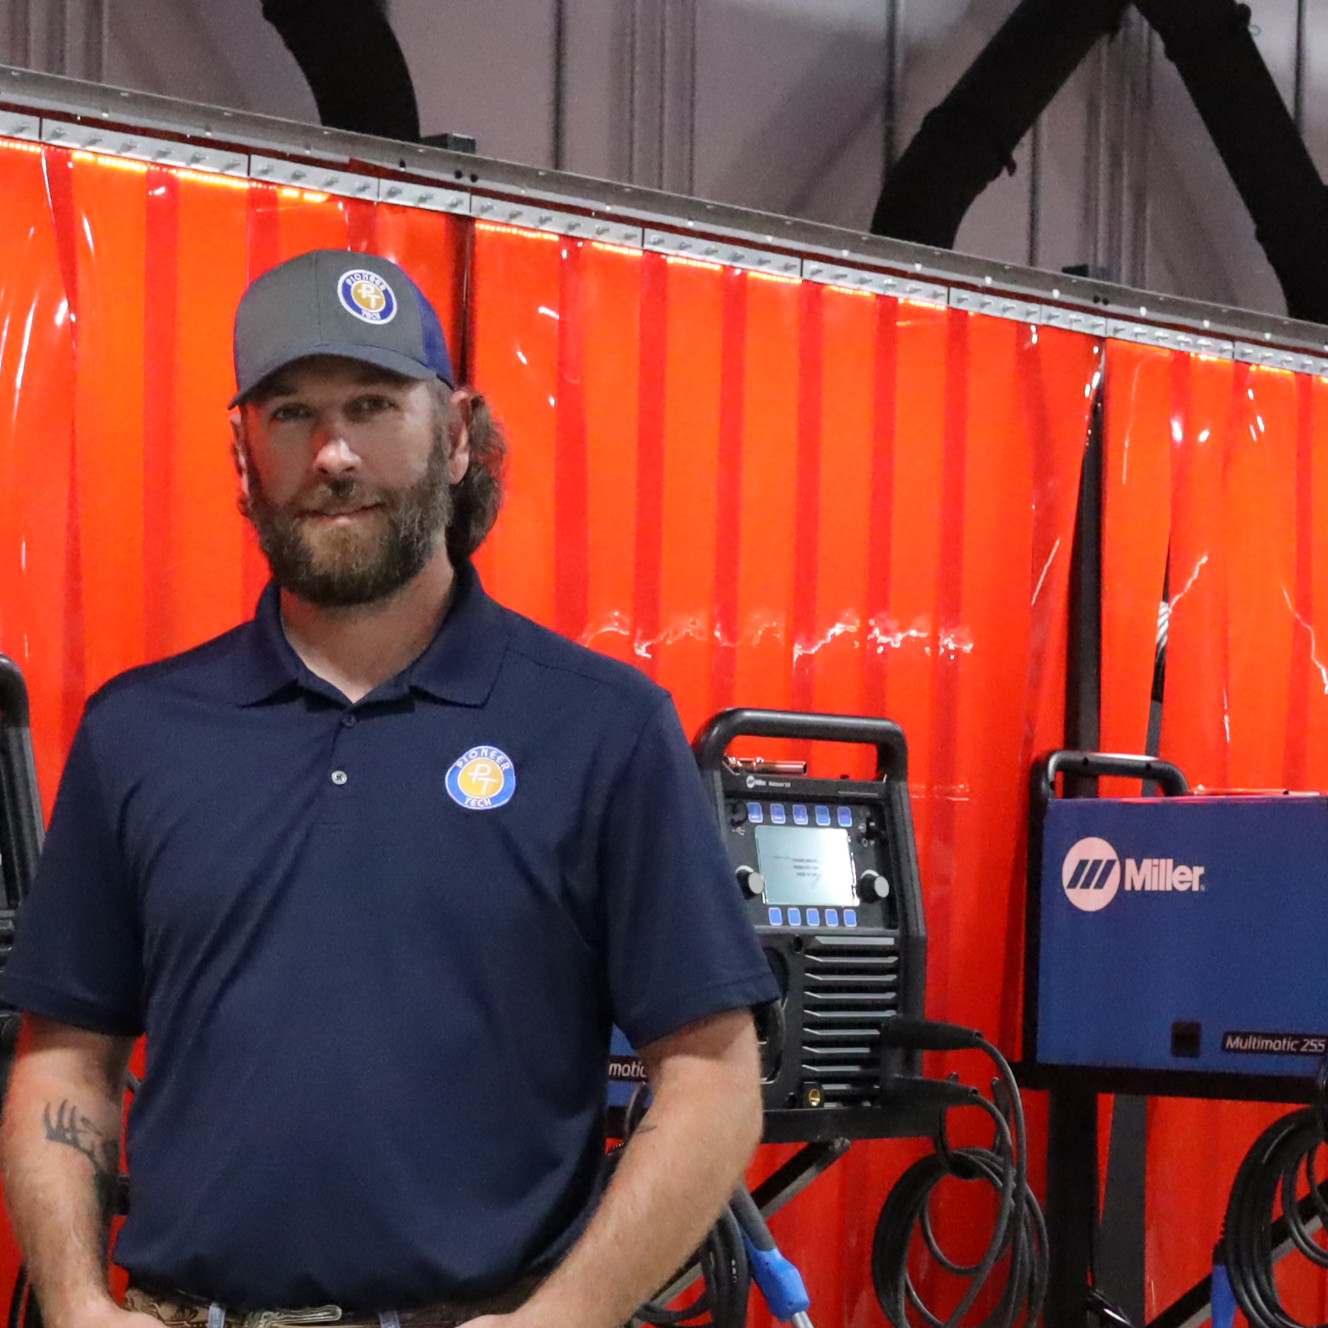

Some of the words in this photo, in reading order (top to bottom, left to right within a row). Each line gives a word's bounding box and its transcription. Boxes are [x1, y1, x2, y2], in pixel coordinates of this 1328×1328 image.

[455, 748, 511, 771] PIONEER
[464, 797, 492, 807] TECH
[1124, 857, 1206, 892] Miller
[1225, 1036, 1299, 1051] Multimatic
[1300, 1039, 1325, 1052] 255
[608, 1061, 647, 1078] matic
